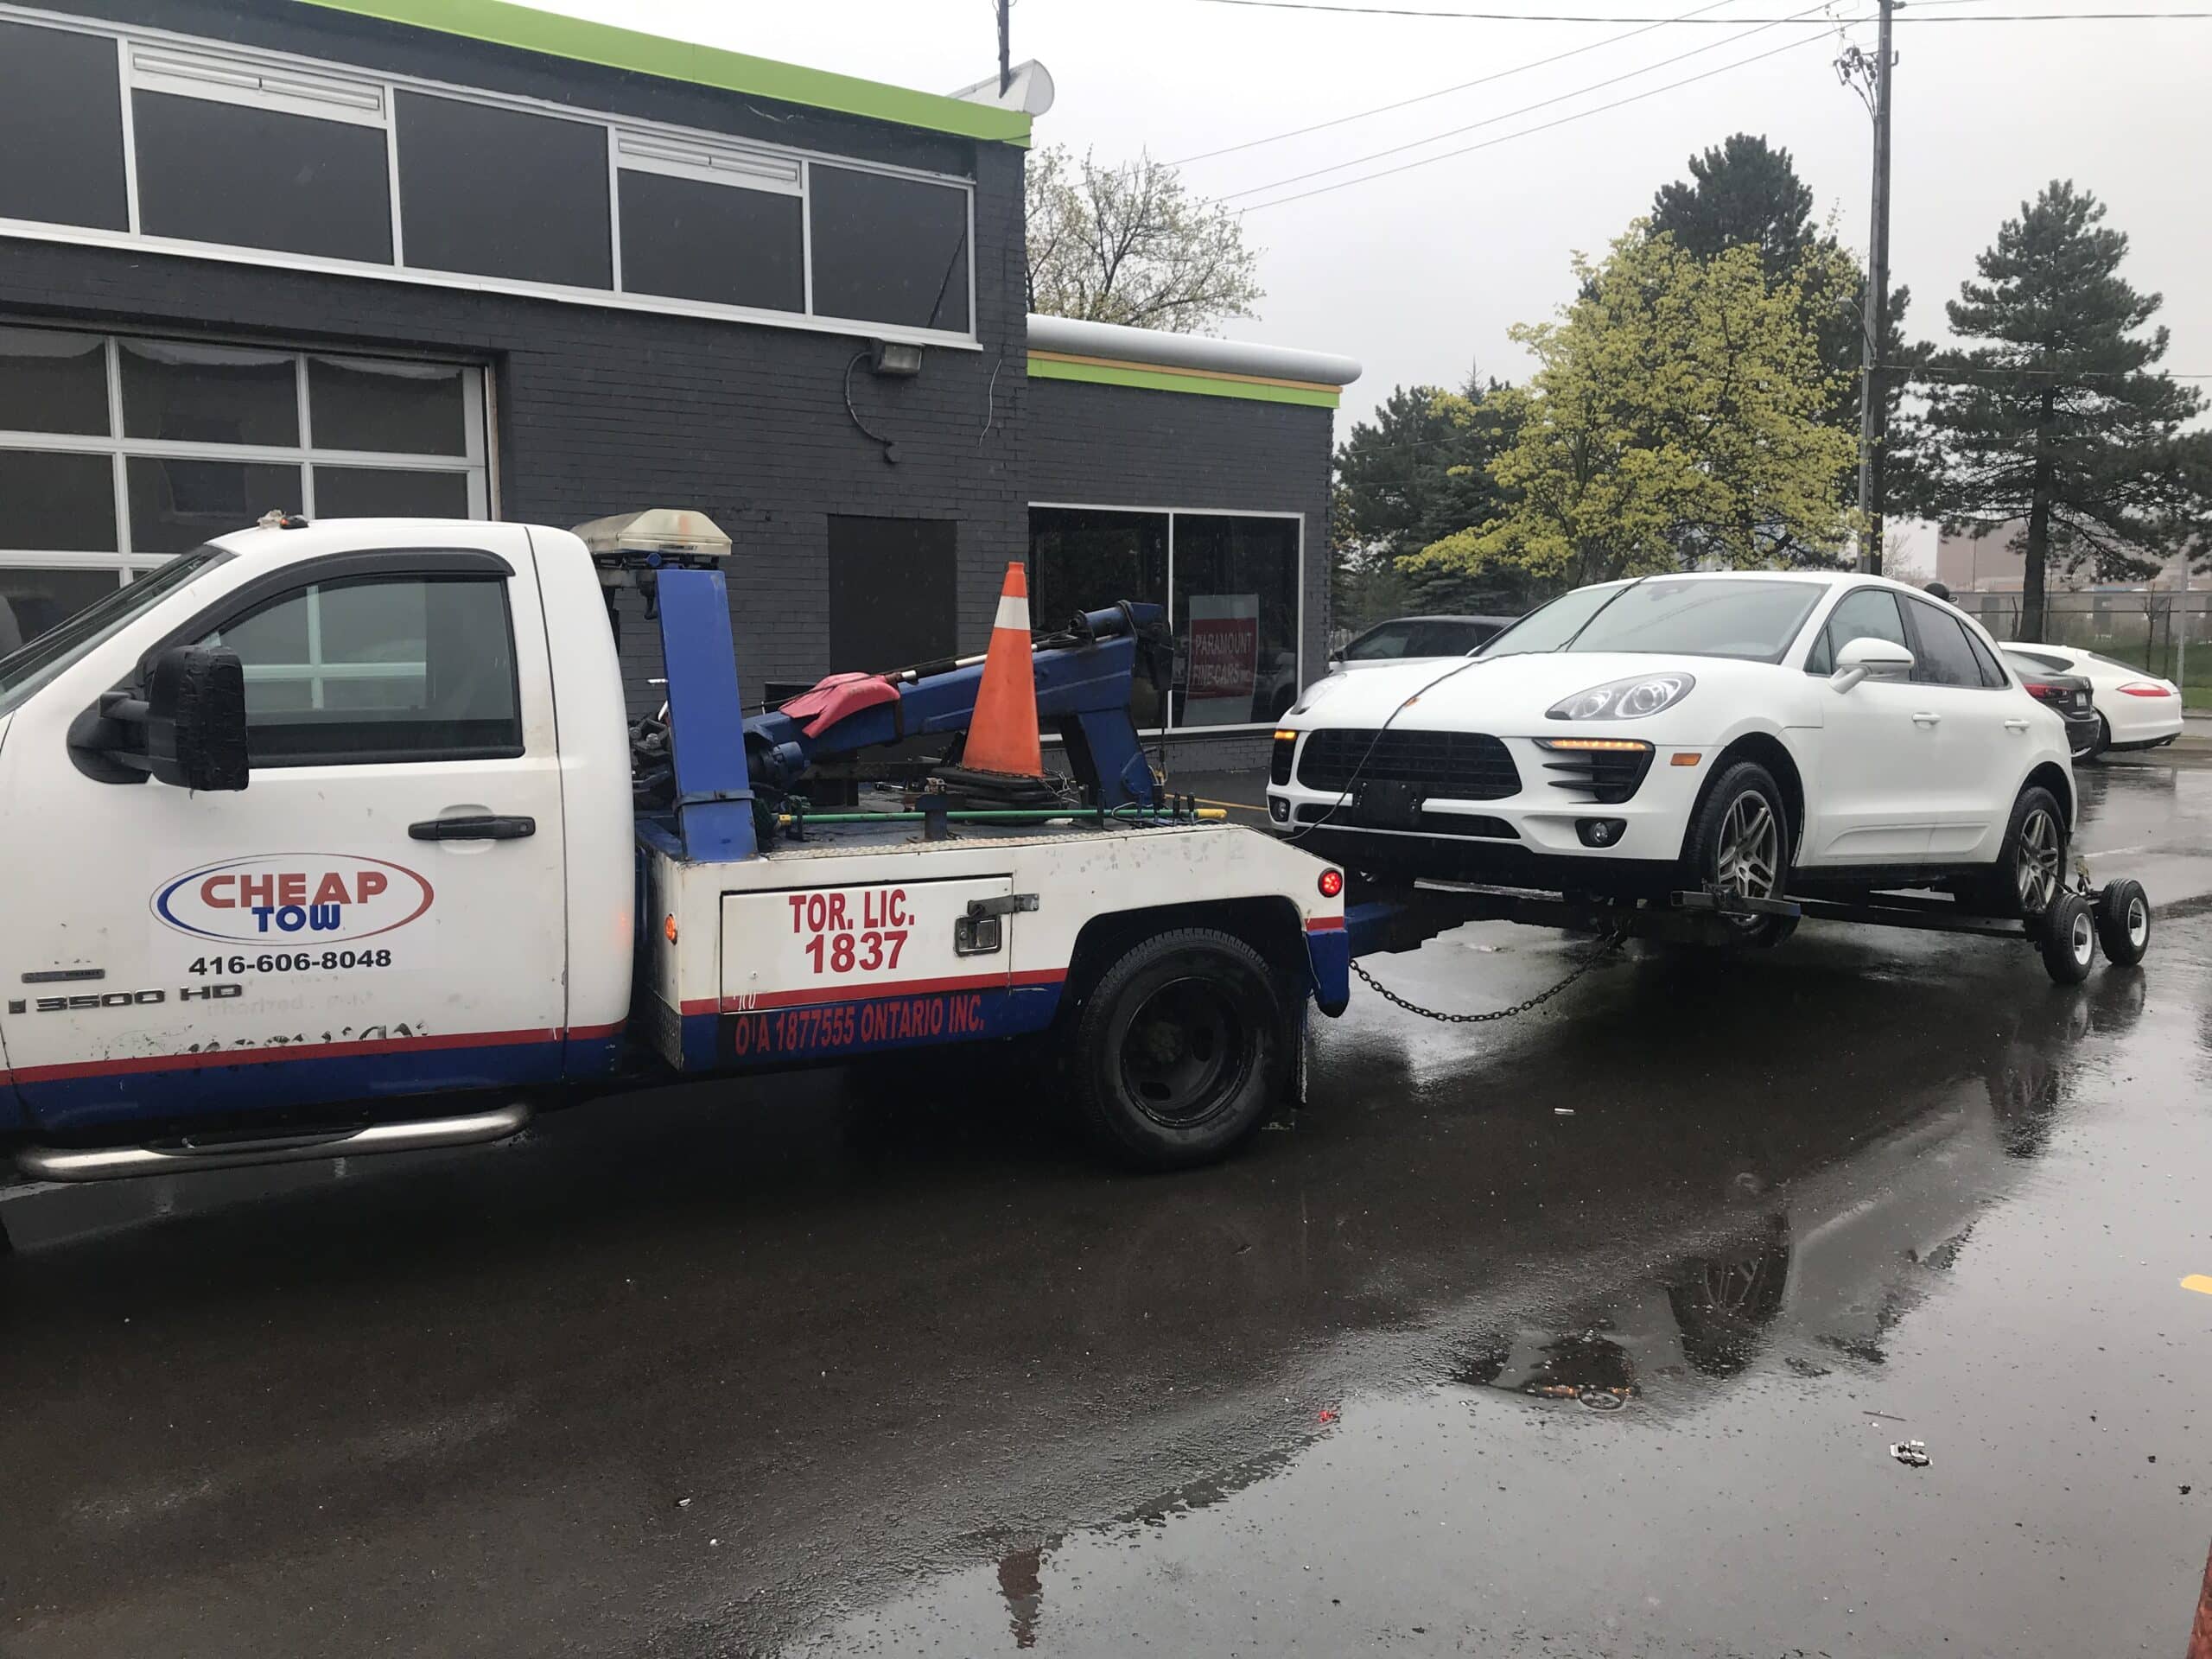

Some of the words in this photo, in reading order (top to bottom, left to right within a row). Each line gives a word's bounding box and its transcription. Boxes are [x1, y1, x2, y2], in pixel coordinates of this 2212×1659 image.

[200, 871, 388, 909] CHEAP
[251, 904, 340, 932] TOW
[789, 893, 854, 933] TOR.
[863, 889, 915, 929] LIC.
[188, 950, 392, 976] 416-606-8048
[805, 931, 908, 974] 1837
[35, 988, 165, 1012] 3500
[180, 983, 243, 1001] HD
[776, 1008, 855, 1051] 1877555
[861, 997, 944, 1042] ONTARIO
[948, 995, 985, 1033] INC.
